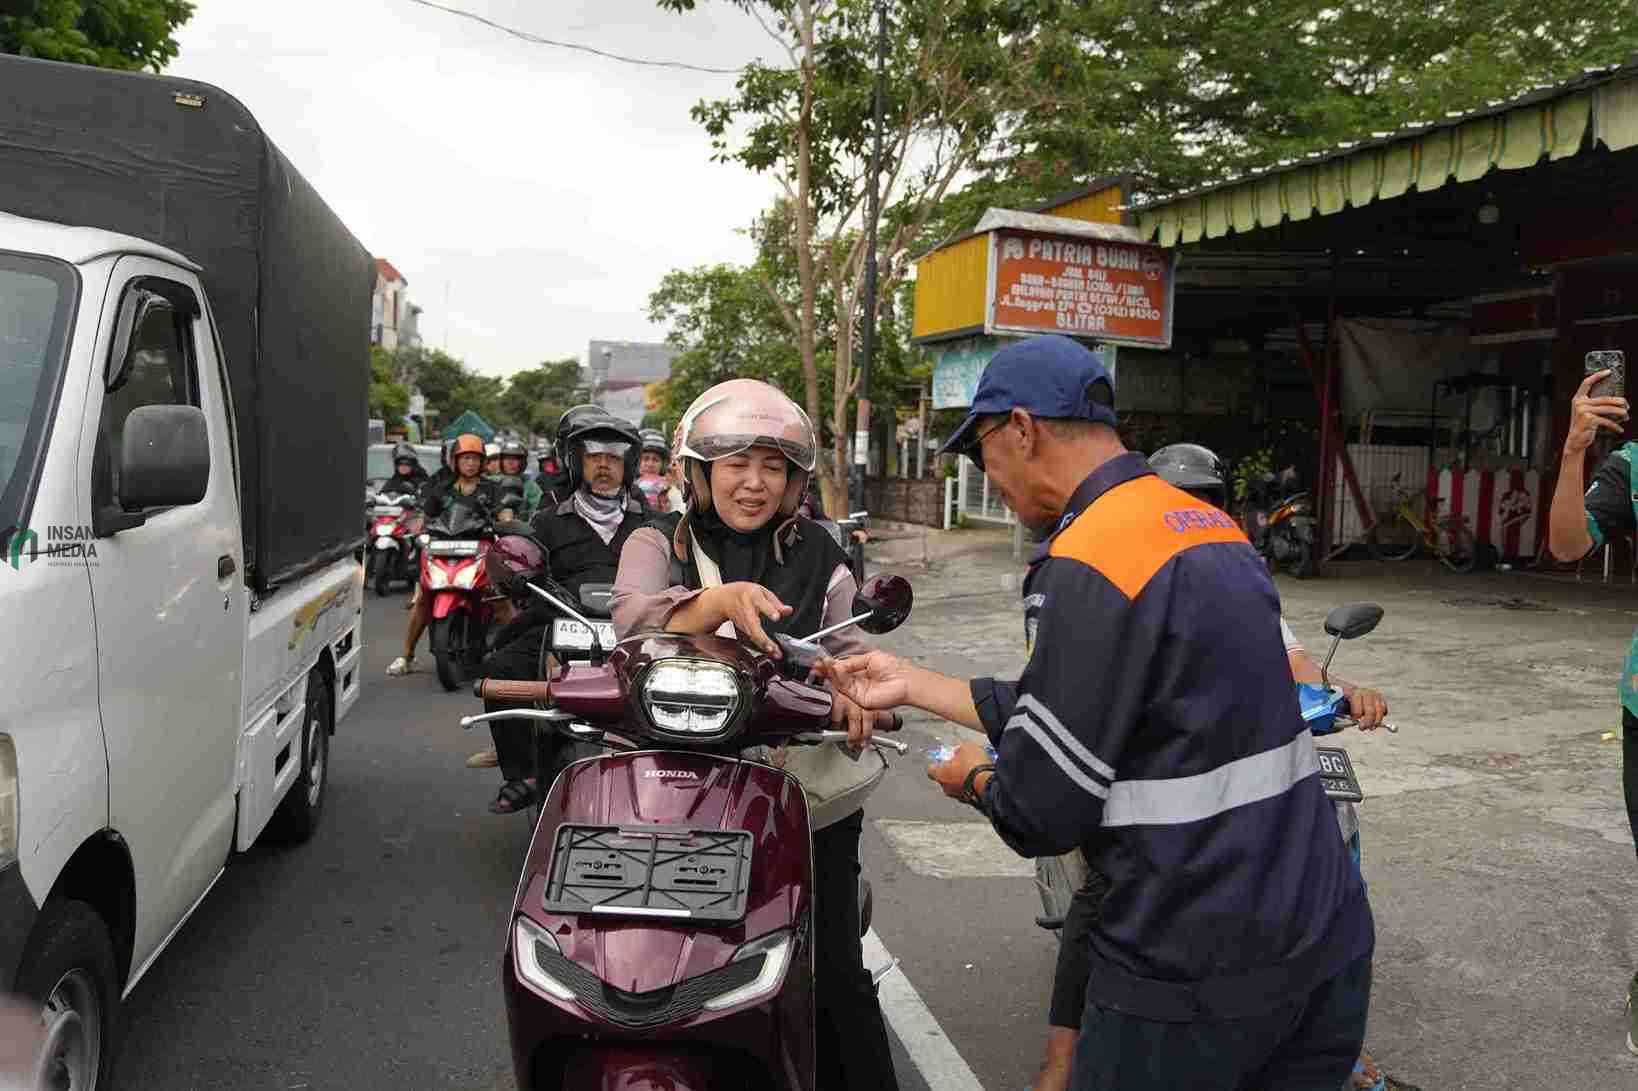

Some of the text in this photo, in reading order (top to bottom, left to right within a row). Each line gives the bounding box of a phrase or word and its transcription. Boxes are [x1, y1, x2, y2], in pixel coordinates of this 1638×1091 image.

[1029, 238, 1092, 266] PATRIA
[1056, 311, 1105, 331] BLITAR
[644, 769, 699, 780] HONDA
